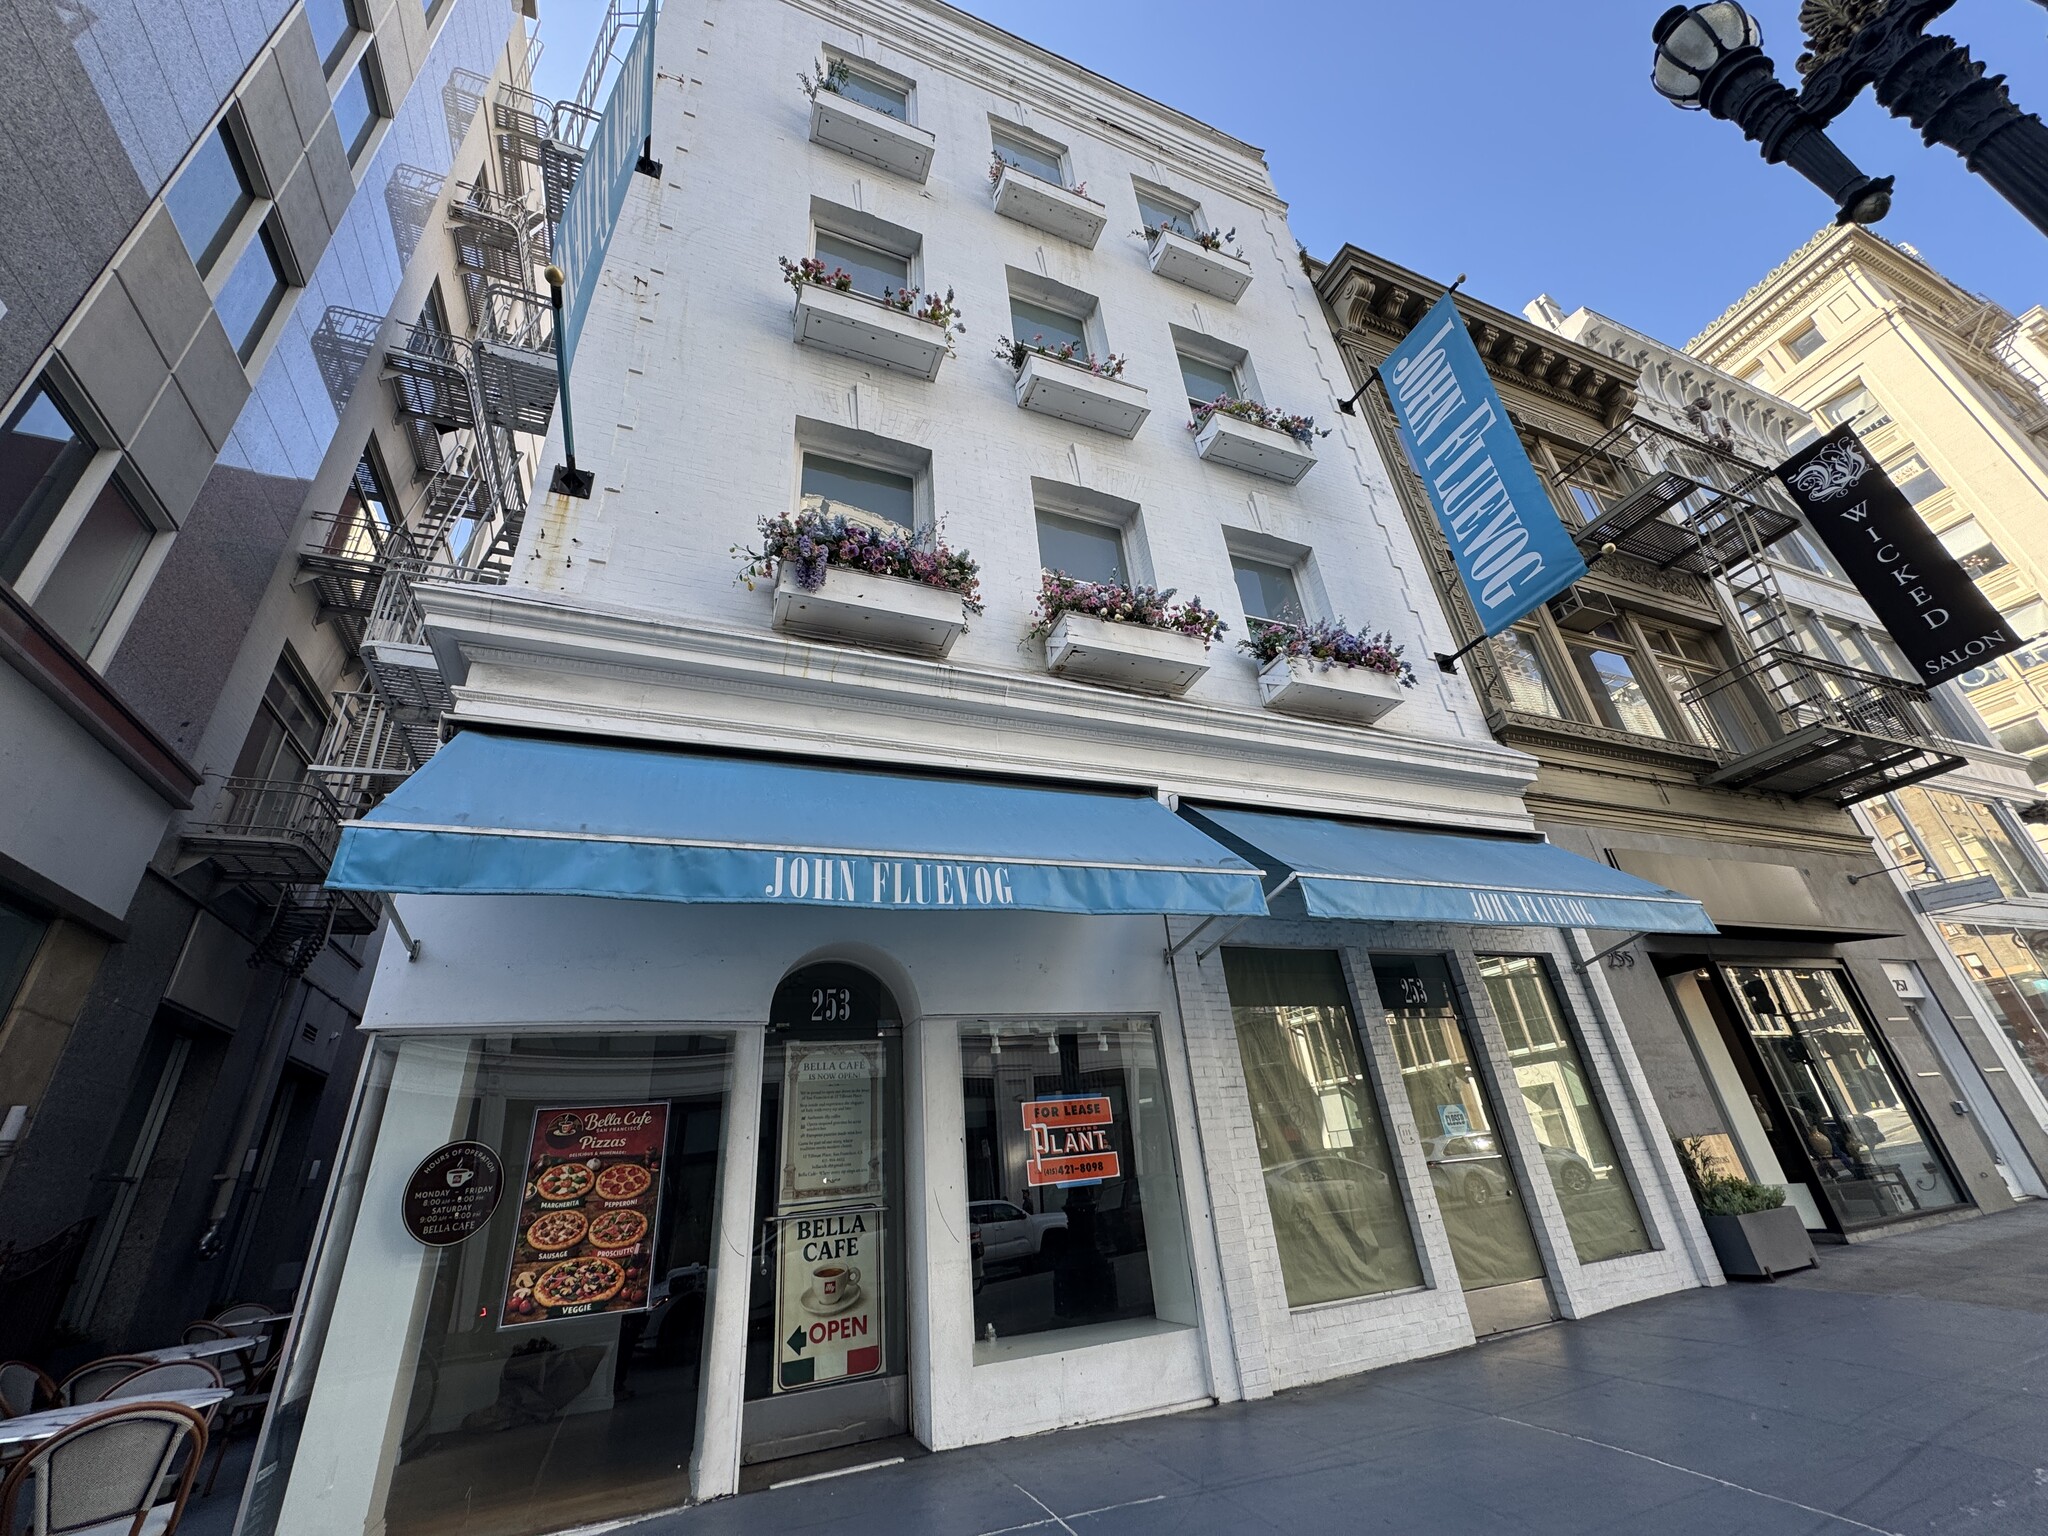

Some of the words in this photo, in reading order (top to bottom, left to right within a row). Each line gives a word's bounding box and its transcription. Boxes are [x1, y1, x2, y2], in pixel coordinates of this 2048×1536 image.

[1392, 317, 1467, 447] JOHN
[1424, 397, 1546, 610] FLUEVOG
[1840, 500, 1951, 630] WICKED
[1925, 629, 2007, 675] SALON
[765, 856, 857, 902] JOHN
[872, 860, 1014, 906] FLUEVOG
[1469, 891, 1521, 922] JOHN
[1517, 894, 1597, 926] FLUEVOG
[1400, 977, 1428, 1004] 253
[811, 988, 851, 1021] 253
[803, 1061, 836, 1071] BELLA
[584, 1112, 622, 1131] Bella
[623, 1110, 653, 1128] Cafe
[1034, 1106, 1060, 1119] FOR
[1063, 1103, 1101, 1117] LEASE
[578, 1135, 627, 1150] Pizzas
[1030, 1122, 1106, 1173] PLANT
[423, 1152, 450, 1174] HOURS
[451, 1148, 463, 1157] OF
[464, 1148, 496, 1174] OPERATION
[414, 1189, 451, 1200] MONDAY
[464, 1185, 494, 1195] FRIDAY
[422, 1198, 441, 1207] 8:00
[540, 1199, 580, 1209] MARGHERITA
[604, 1198, 638, 1208] PEPPERONI
[419, 1215, 438, 1224] 9:00
[431, 1204, 473, 1215] SATURDAY
[422, 1223, 450, 1235] BELLA
[451, 1221, 476, 1231] CAFE
[796, 1214, 867, 1241] BELLA
[538, 1250, 569, 1260] SAUSAGE
[802, 1237, 859, 1262] CAFE
[562, 1302, 593, 1315] VEGGIE
[808, 1314, 868, 1344] OPEN
